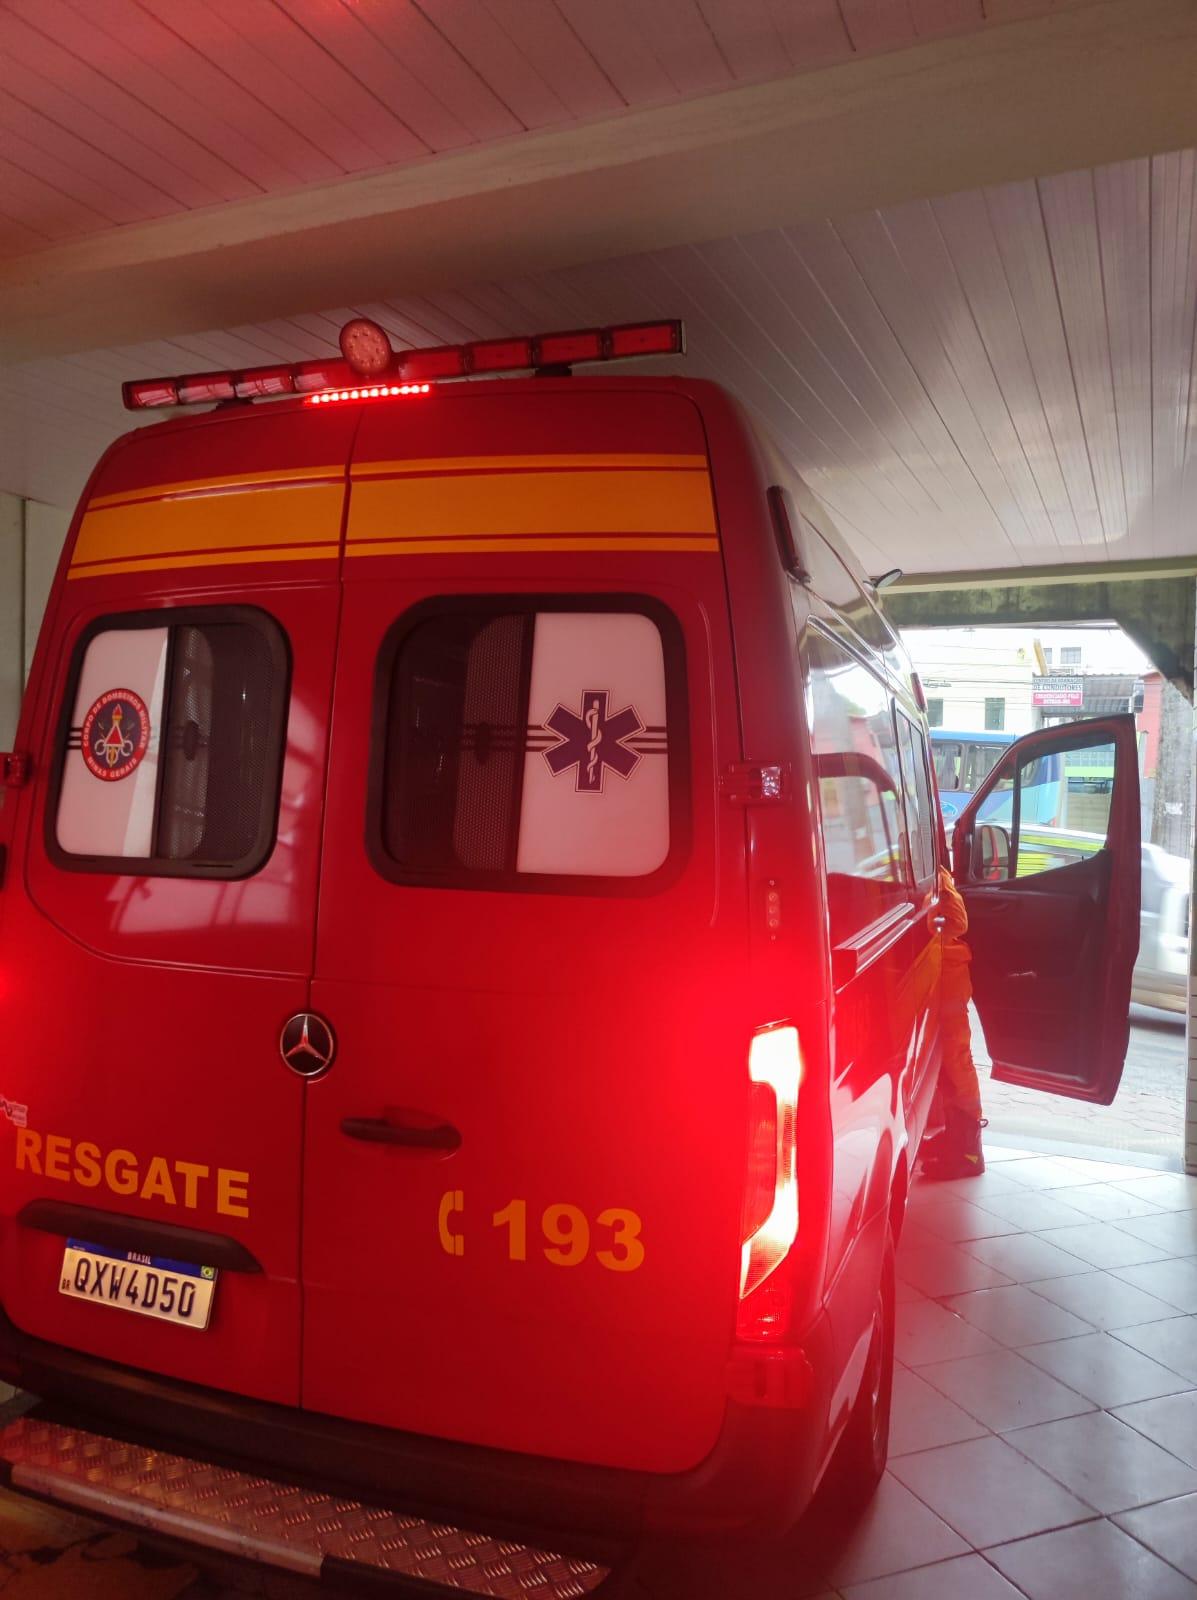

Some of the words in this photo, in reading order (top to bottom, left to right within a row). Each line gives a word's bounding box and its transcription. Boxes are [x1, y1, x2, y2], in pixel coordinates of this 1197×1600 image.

[83, 715, 95, 748] CORPO
[93, 702, 102, 714] DE
[102, 691, 142, 710] BOMBEIROS
[87, 756, 107, 778] MINAS
[110, 757, 138, 778] GERAIS
[15, 1127, 250, 1219] RESGATE
[127, 1251, 152, 1265] BRASIL
[492, 1199, 646, 1273] 193
[75, 1257, 196, 1317] QXW4D50
